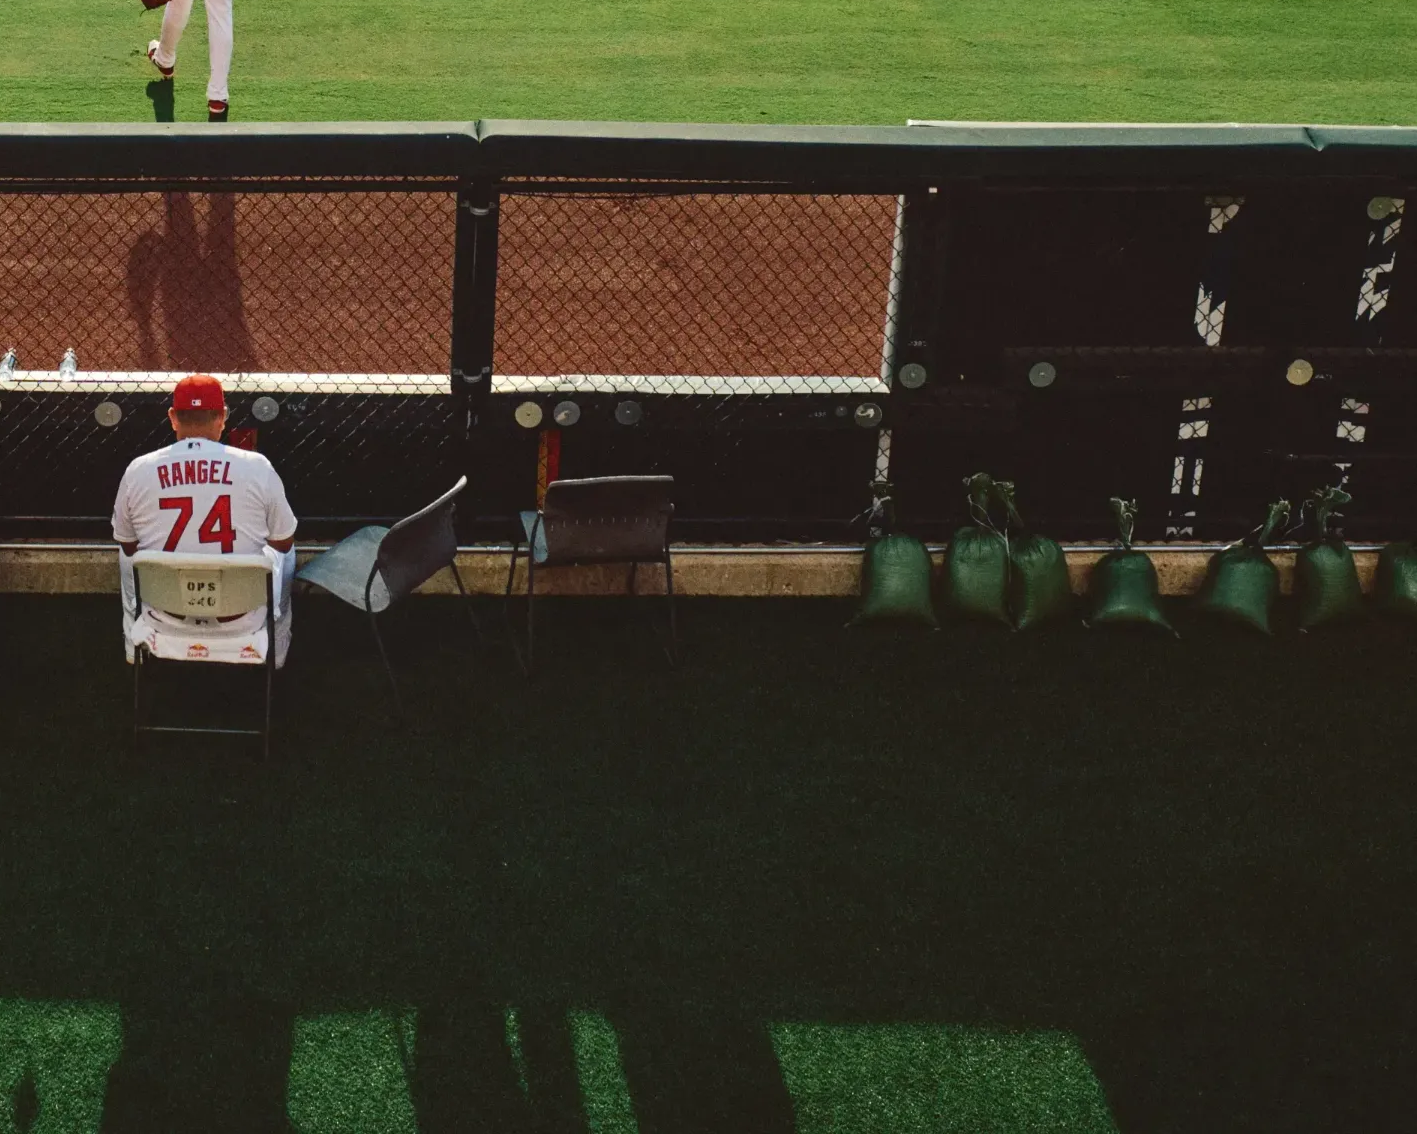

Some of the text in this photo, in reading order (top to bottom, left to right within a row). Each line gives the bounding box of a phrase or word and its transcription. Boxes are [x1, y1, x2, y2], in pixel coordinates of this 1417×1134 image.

[158, 460, 233, 489] RANGEL
[159, 495, 236, 554] 74
[187, 582, 216, 591] OPS
